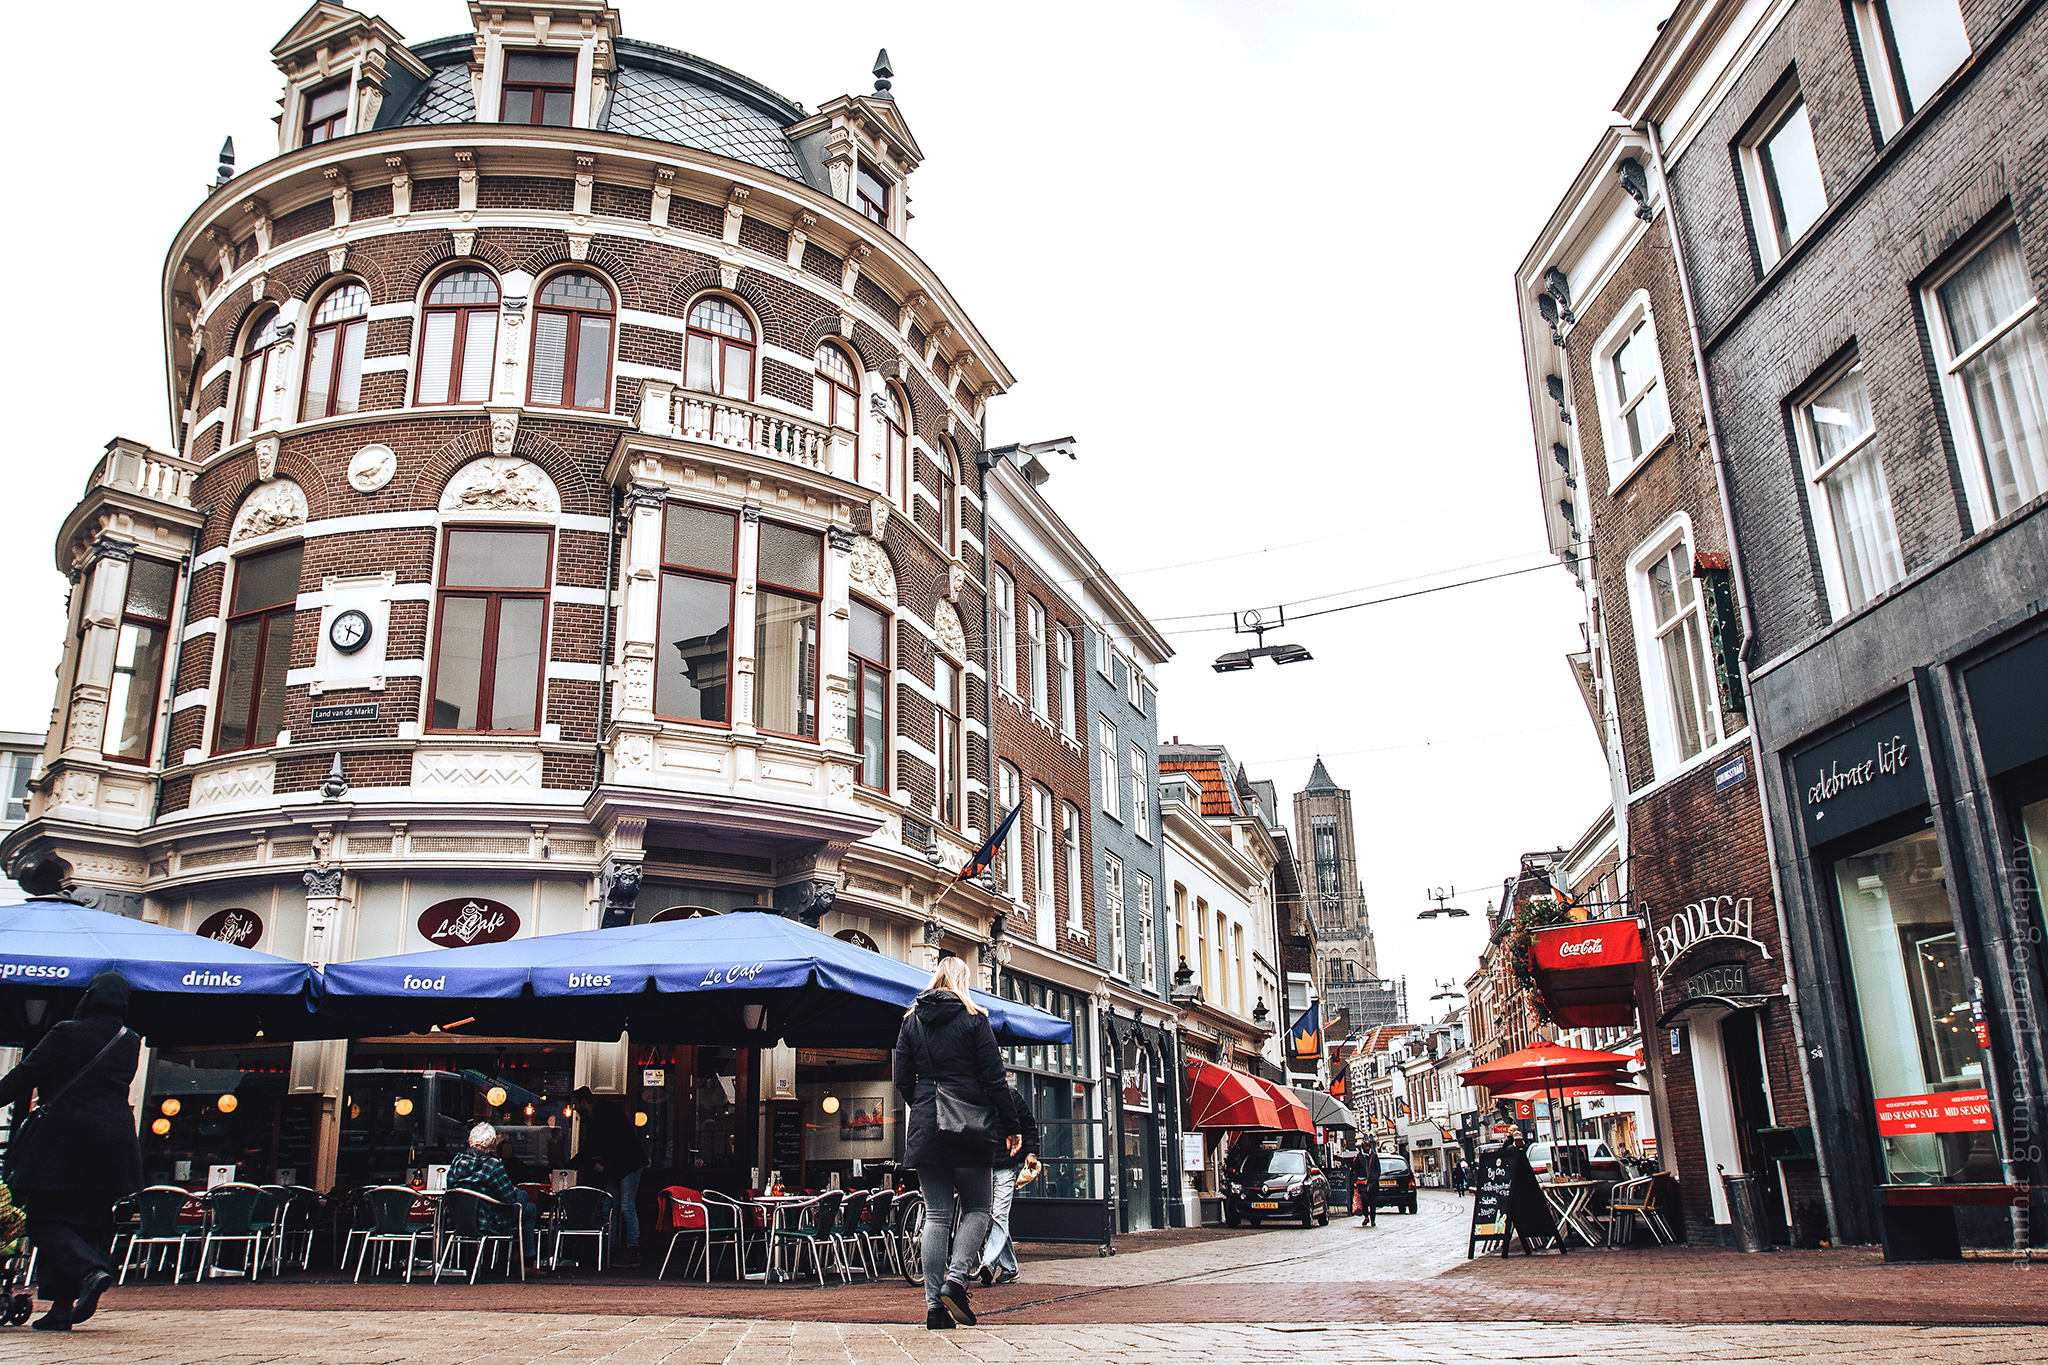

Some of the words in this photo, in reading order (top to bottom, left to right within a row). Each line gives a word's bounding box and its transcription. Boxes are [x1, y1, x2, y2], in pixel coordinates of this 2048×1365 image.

[345, 708, 353, 716] de
[354, 707, 374, 715] Markt
[1807, 760, 1875, 804] celebrate
[1878, 735, 1909, 774] life
[430, 918, 457, 939] Le
[461, 911, 506, 935] Café
[1656, 895, 1753, 966] BODEGA
[1559, 938, 1603, 957] Coca-Cola
[181, 970, 242, 987] drinks
[403, 974, 446, 991] food
[567, 973, 612, 988] bites
[699, 967, 722, 987] Le
[725, 962, 764, 984] Café
[1686, 968, 1744, 998] BODEGA
[1880, 1112, 1893, 1121] MID
[1893, 1110, 1920, 1121] SEASON
[1921, 1108, 1939, 1118] SALE
[1944, 1106, 1959, 1117] MID
[1960, 1104, 1990, 1116] SEASON
